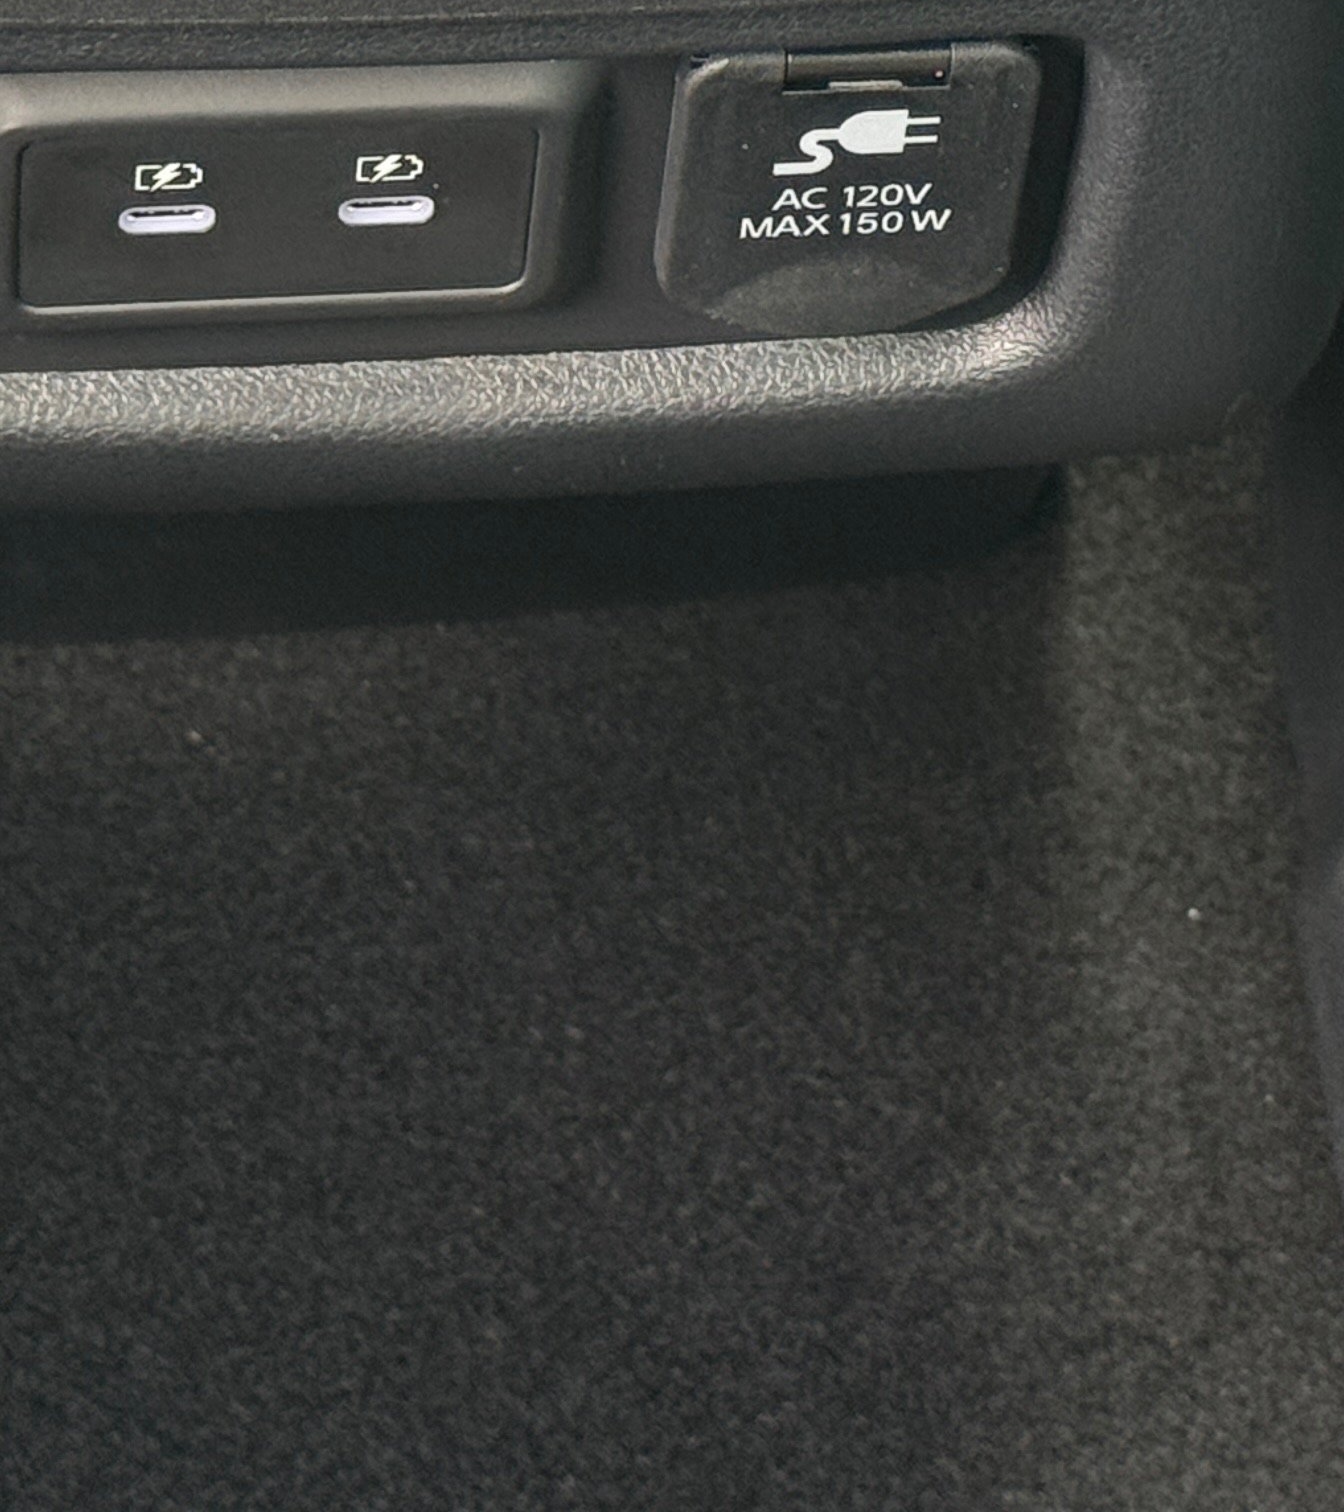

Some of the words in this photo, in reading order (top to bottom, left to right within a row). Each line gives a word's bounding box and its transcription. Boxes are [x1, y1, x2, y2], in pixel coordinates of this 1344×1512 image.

[770, 186, 829, 211] AC
[842, 182, 933, 208] 120V
[738, 212, 831, 239] MAX
